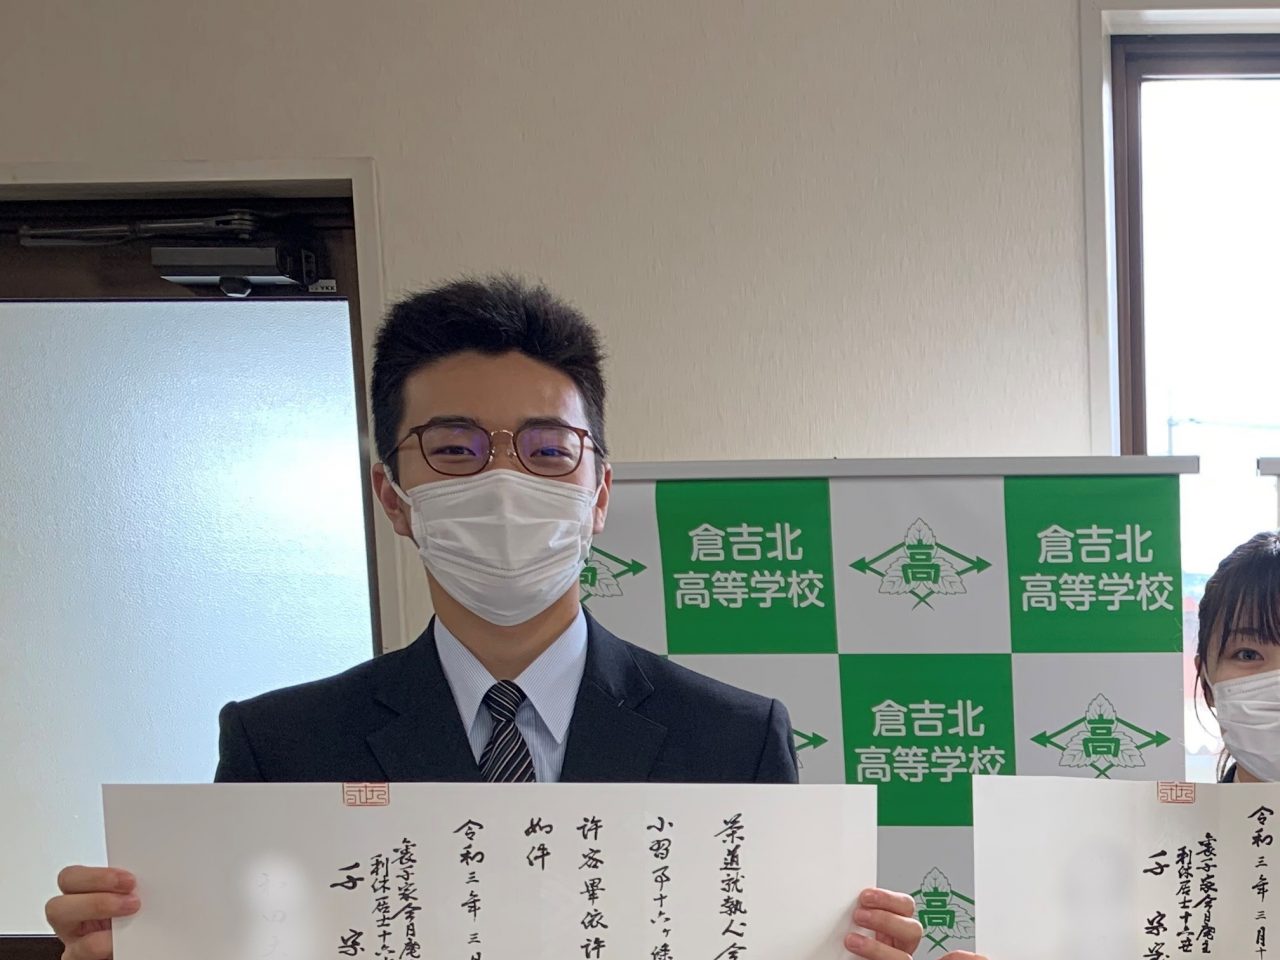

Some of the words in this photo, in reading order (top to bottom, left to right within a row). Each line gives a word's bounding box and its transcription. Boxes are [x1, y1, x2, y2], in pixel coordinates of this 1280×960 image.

[687, 521, 804, 562] 倉吉北
[1037, 523, 1154, 565] 倉吉北
[674, 569, 825, 610] 高等学校
[1020, 571, 1174, 612] 高等学校
[871, 698, 986, 738] 倉吉北
[854, 745, 1006, 783] 高等学校
